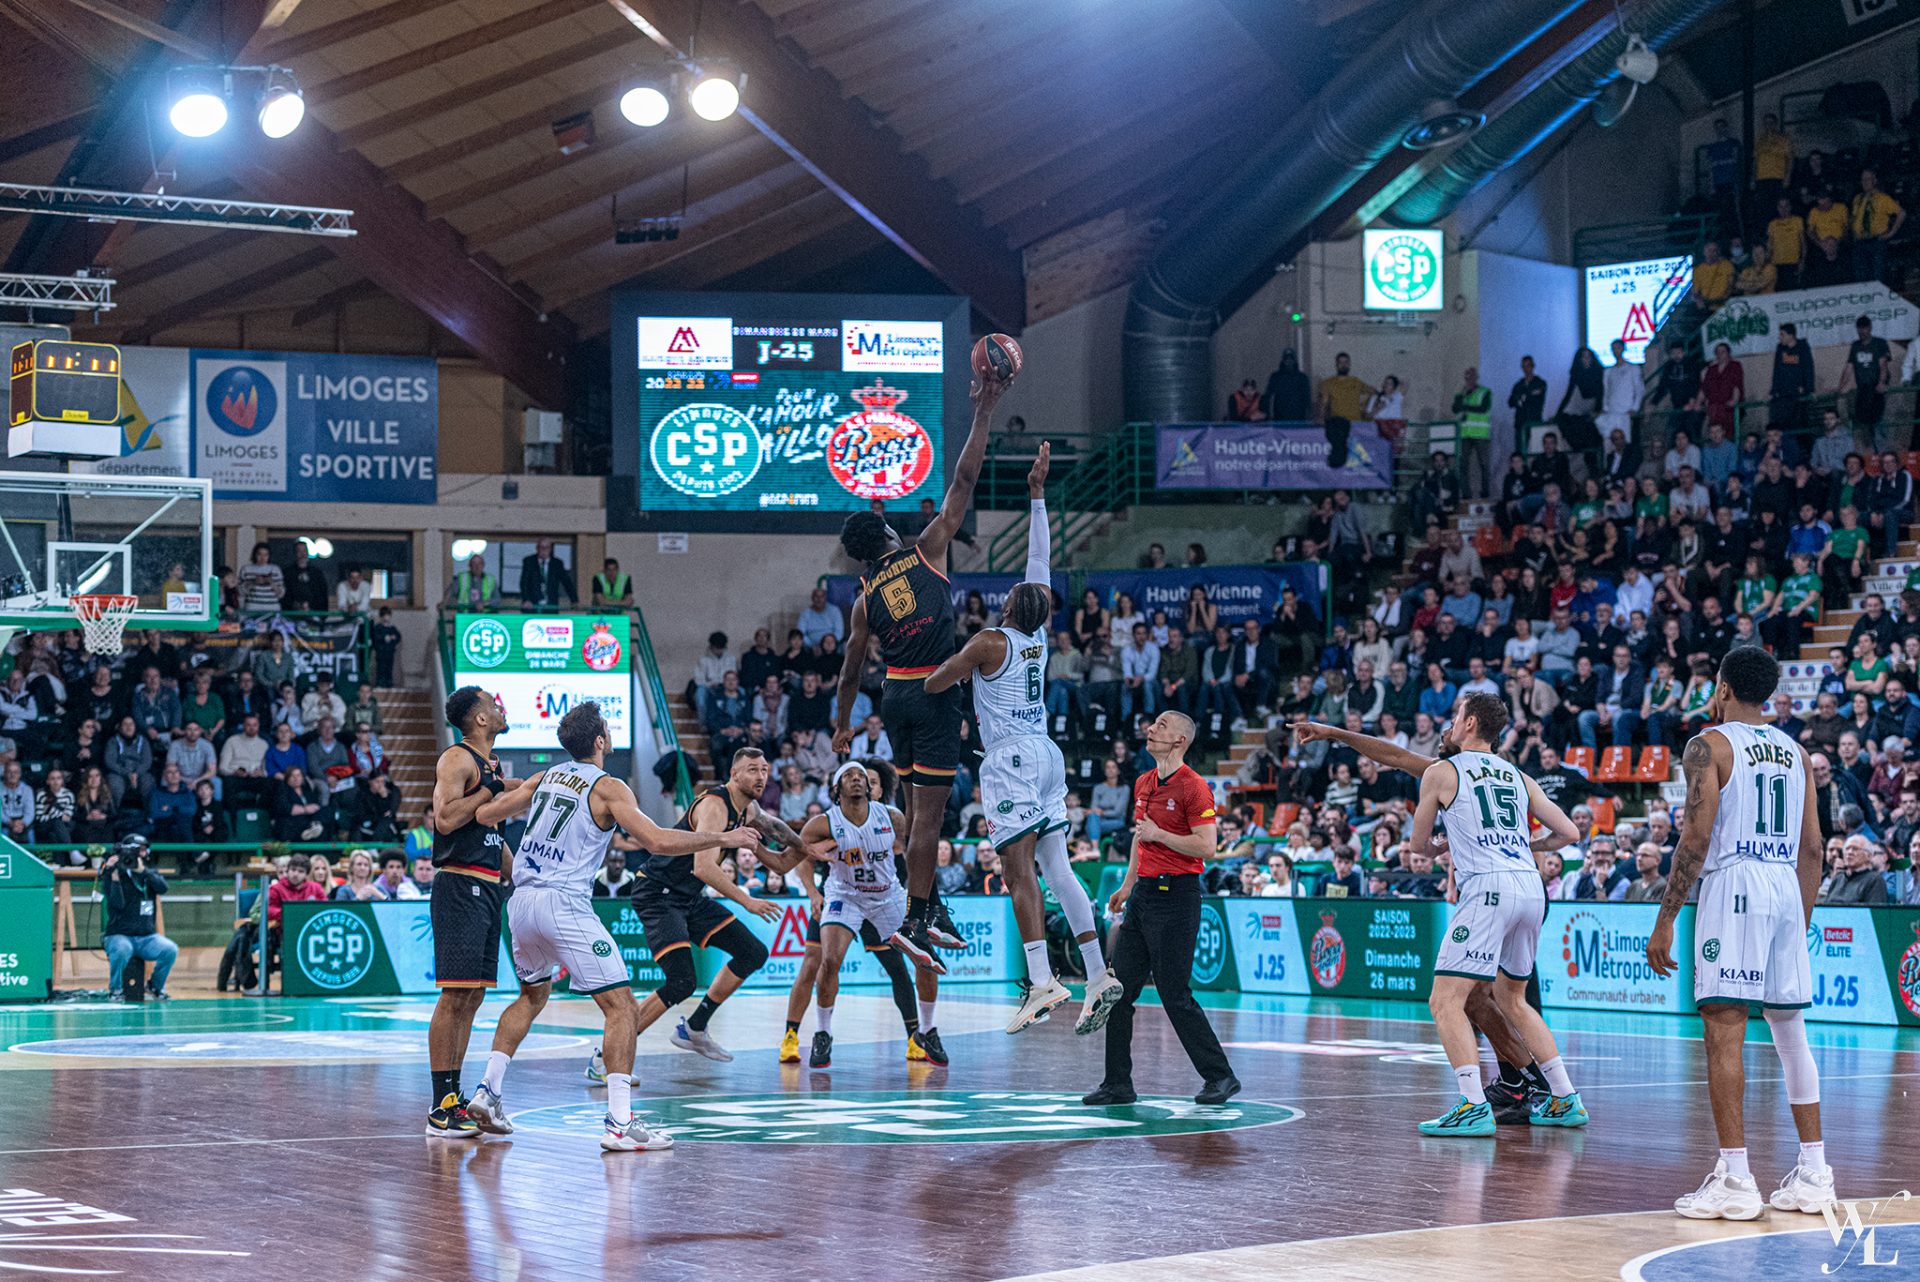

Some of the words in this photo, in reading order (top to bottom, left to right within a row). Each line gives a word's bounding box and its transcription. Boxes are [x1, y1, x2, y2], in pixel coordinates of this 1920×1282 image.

[757, 339, 815, 365] J-25
[298, 373, 429, 403] LIMOGES
[327, 419, 400, 446] VILLE
[205, 445, 279, 460] LIMOGES
[666, 422, 748, 466] CSP
[1214, 438, 1333, 456] Haute-Vienne
[97, 462, 183, 477] département
[300, 454, 434, 481] SPORTIVE
[1214, 460, 1251, 471] notre
[1252, 458, 1329, 472] départemen
[879, 574, 917, 622] 5
[900, 615, 934, 634] LATTICE
[469, 629, 505, 653] CSP
[1025, 662, 1043, 705] 6
[1012, 755, 1021, 768] 6
[1744, 742, 1794, 770] JONES
[1474, 784, 1518, 831] 15
[1755, 772, 1788, 837] 11
[854, 868, 876, 883] 23
[1484, 891, 1500, 906] 15
[1734, 894, 1748, 914] 11
[311, 913, 359, 932] LIMOGES
[1374, 909, 1411, 924] SAISON
[1368, 924, 1417, 939] 2022-2023
[1825, 930, 1851, 940] Betclic
[308, 925, 363, 964] CSP
[593, 942, 610, 954] CSP
[1826, 944, 1851, 958] ÉLITE
[1254, 953, 1285, 981] J.25
[1365, 948, 1421, 969] Dimanche
[952, 964, 992, 976] urbaine
[1720, 967, 1764, 982] KIABI
[1370, 971, 1385, 990] 26
[1387, 975, 1417, 992] mars
[1812, 973, 1859, 1008] J.25
[1567, 986, 1627, 1002] Communauté
[1630, 989, 1666, 1004] urbaine
